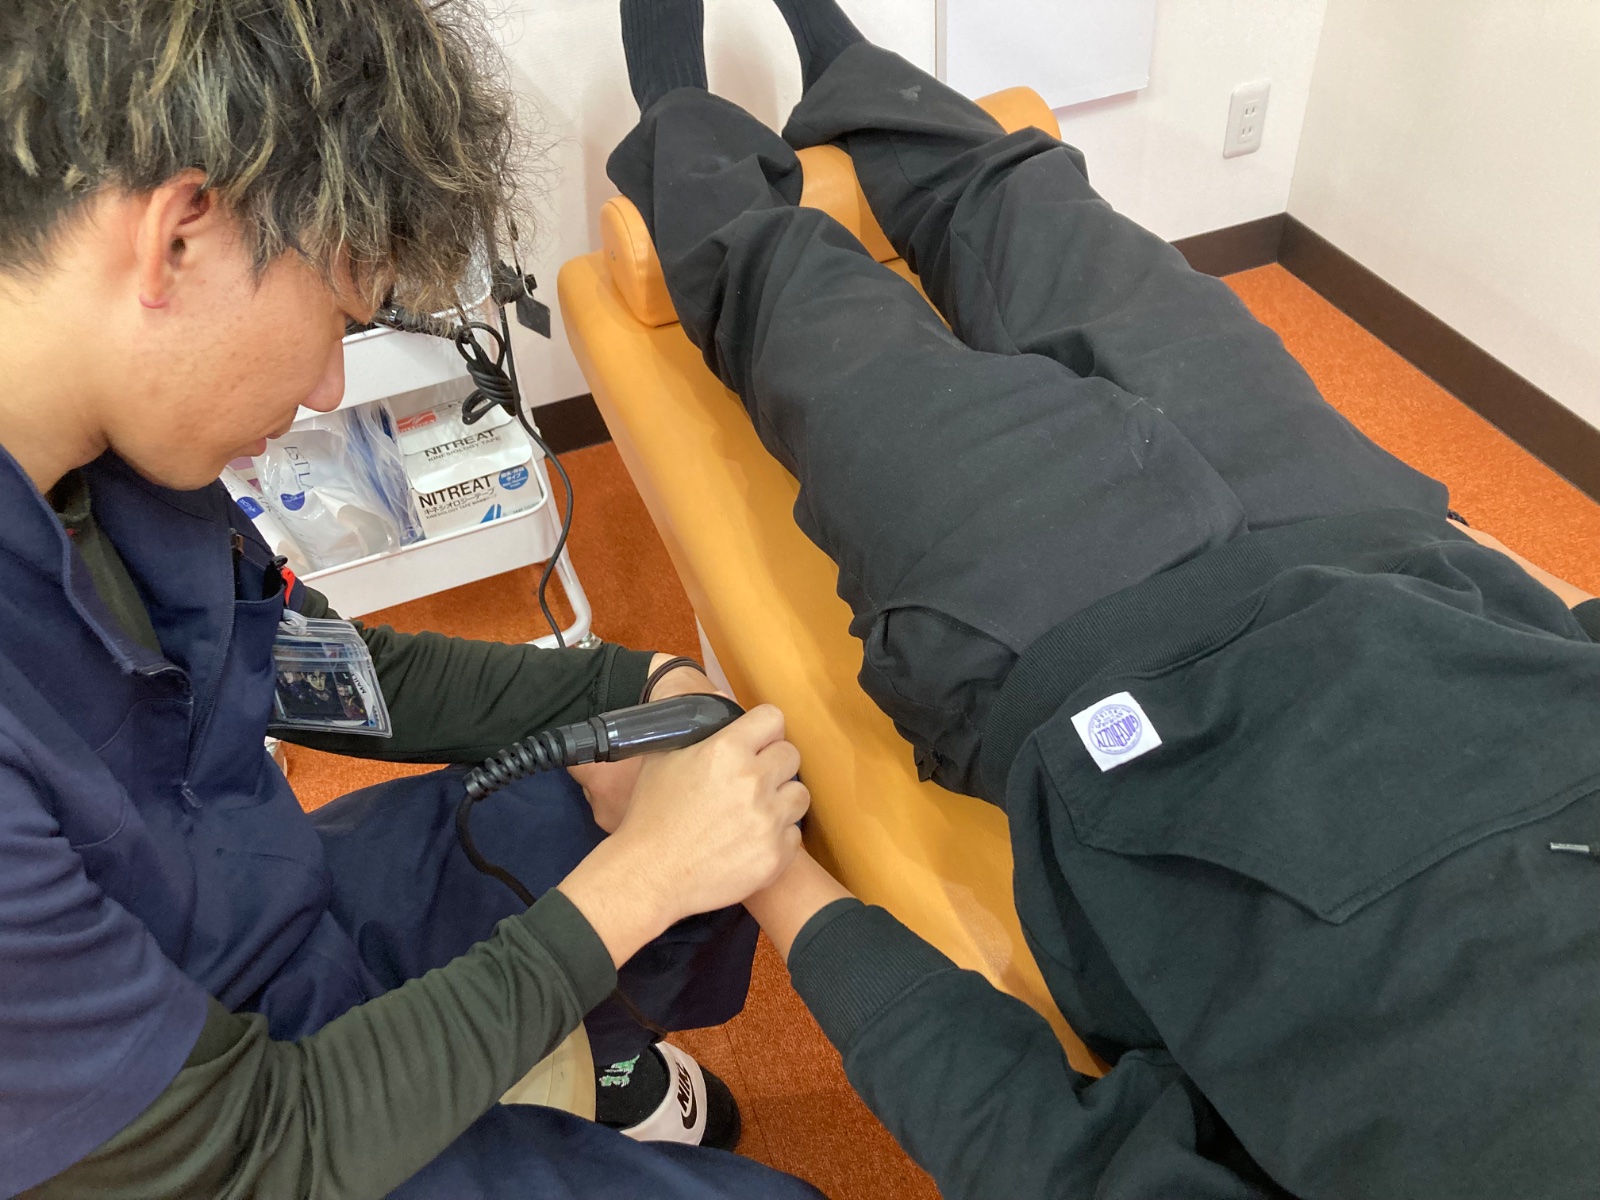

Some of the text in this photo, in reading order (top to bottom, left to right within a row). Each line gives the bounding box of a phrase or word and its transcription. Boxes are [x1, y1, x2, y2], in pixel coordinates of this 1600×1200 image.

[424, 428, 497, 458] NITREAT
[428, 436, 501, 462] KINESIOLOGY TAPE
[418, 474, 492, 508] NITREAT
[424, 487, 496, 515] キネシオロジーテープ
[675, 1060, 692, 1113] NIKE
